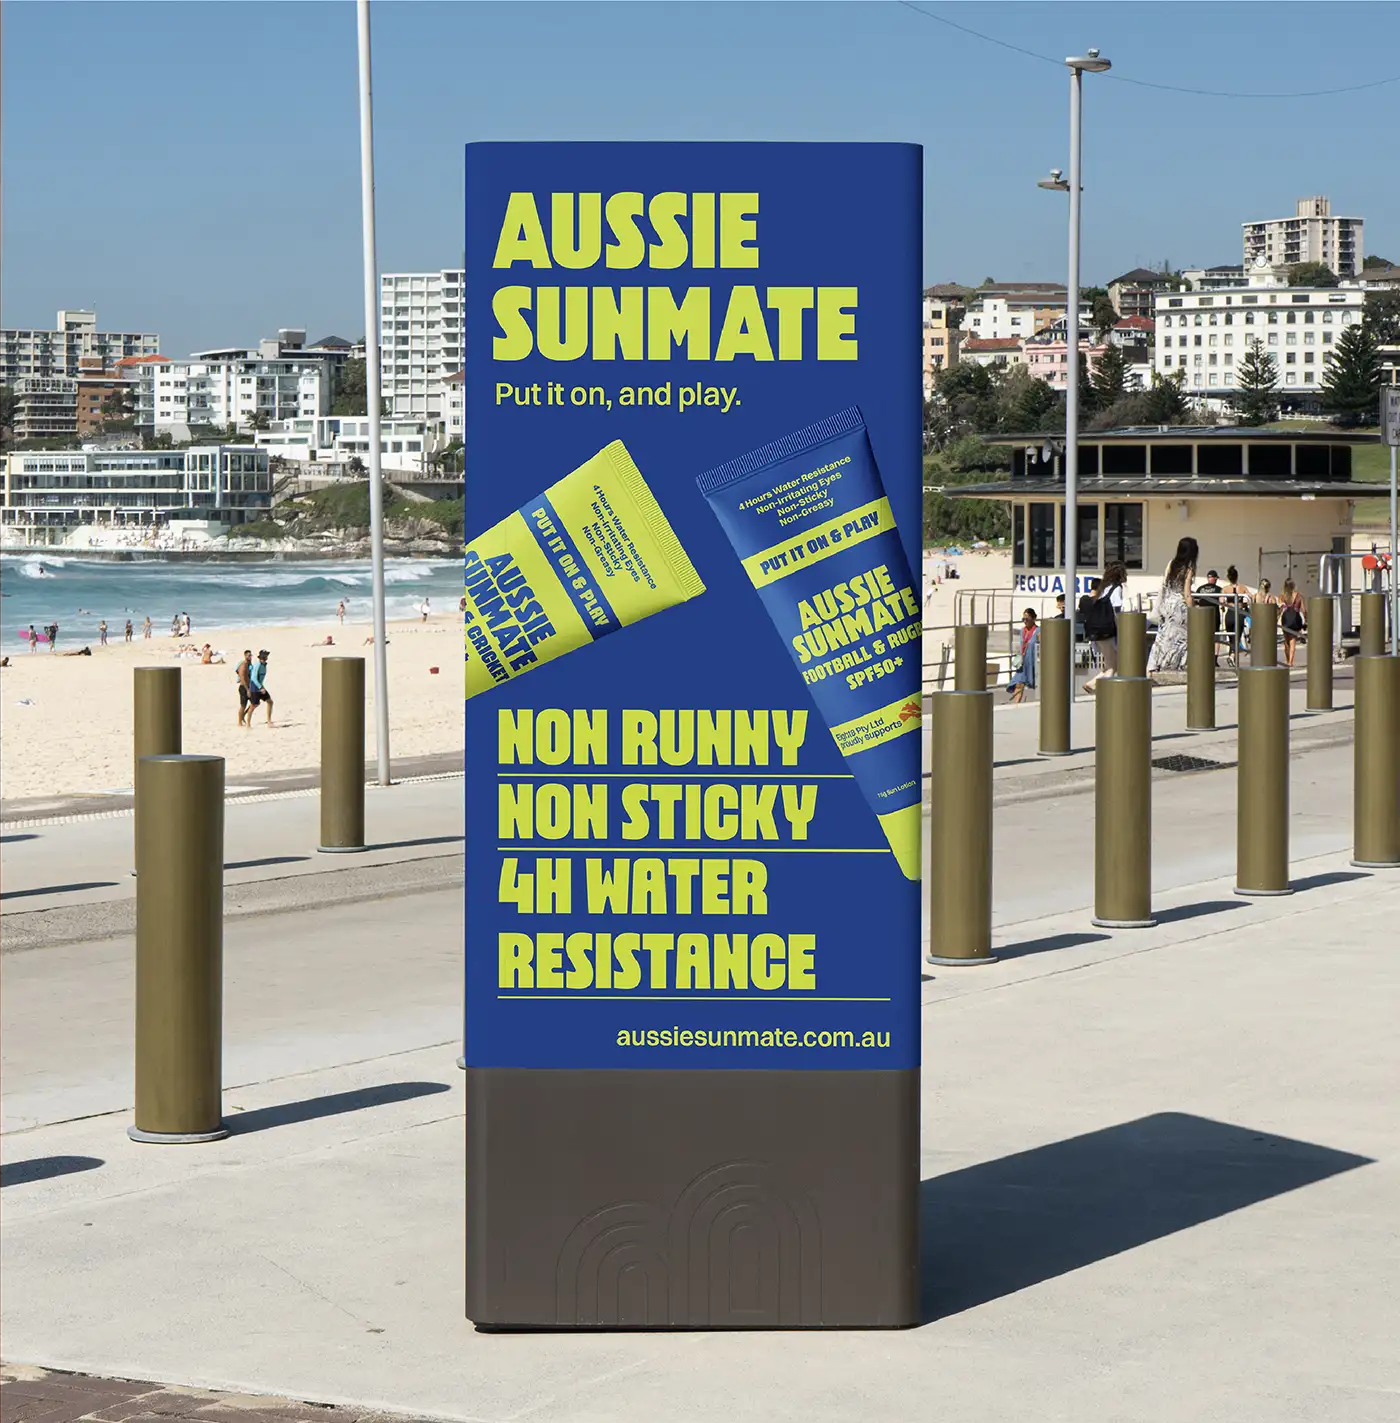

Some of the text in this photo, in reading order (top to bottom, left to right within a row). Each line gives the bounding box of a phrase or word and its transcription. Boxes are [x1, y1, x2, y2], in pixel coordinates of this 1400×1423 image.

[492, 192, 759, 269] AUSSIE
[492, 285, 858, 361] SUNMATE
[495, 382, 741, 412] Put it on, and play.
[738, 456, 852, 511] 4 Hours Water Resistance
[756, 472, 842, 514] Non-Irritating Eyes
[777, 488, 828, 517] Non-Sticky
[778, 497, 834, 527] Non-Greasy
[531, 507, 609, 626] PUT IT ON & PLAY
[582, 526, 615, 577] Non-Greasy
[591, 502, 640, 582] Non-Irritating Eyes
[592, 522, 623, 571] Non-Sticky
[596, 489, 614, 517] Hours
[612, 515, 631, 543] Water
[627, 542, 657, 590] Resistance
[760, 511, 879, 575] PUT IT ON & PLAY
[484, 552, 557, 646] AUSSIE
[792, 586, 919, 664] SUNMATE
[797, 564, 895, 631] AUSSIE
[467, 625, 510, 683] CRICKET
[802, 646, 872, 685] FOOTBALL
[872, 640, 886, 655] &
[846, 656, 903, 690] SPF50+
[498, 709, 808, 766] NON RUNNY
[840, 720, 902, 750] proudly supports
[855, 724, 869, 734] Pty
[869, 717, 884, 729] Ltd
[498, 783, 818, 840] NON STICKY
[498, 858, 768, 915] 4H WATER
[498, 932, 816, 990] RESISTANCE
[616, 1026, 891, 1048] aussiesunmate.com.au
